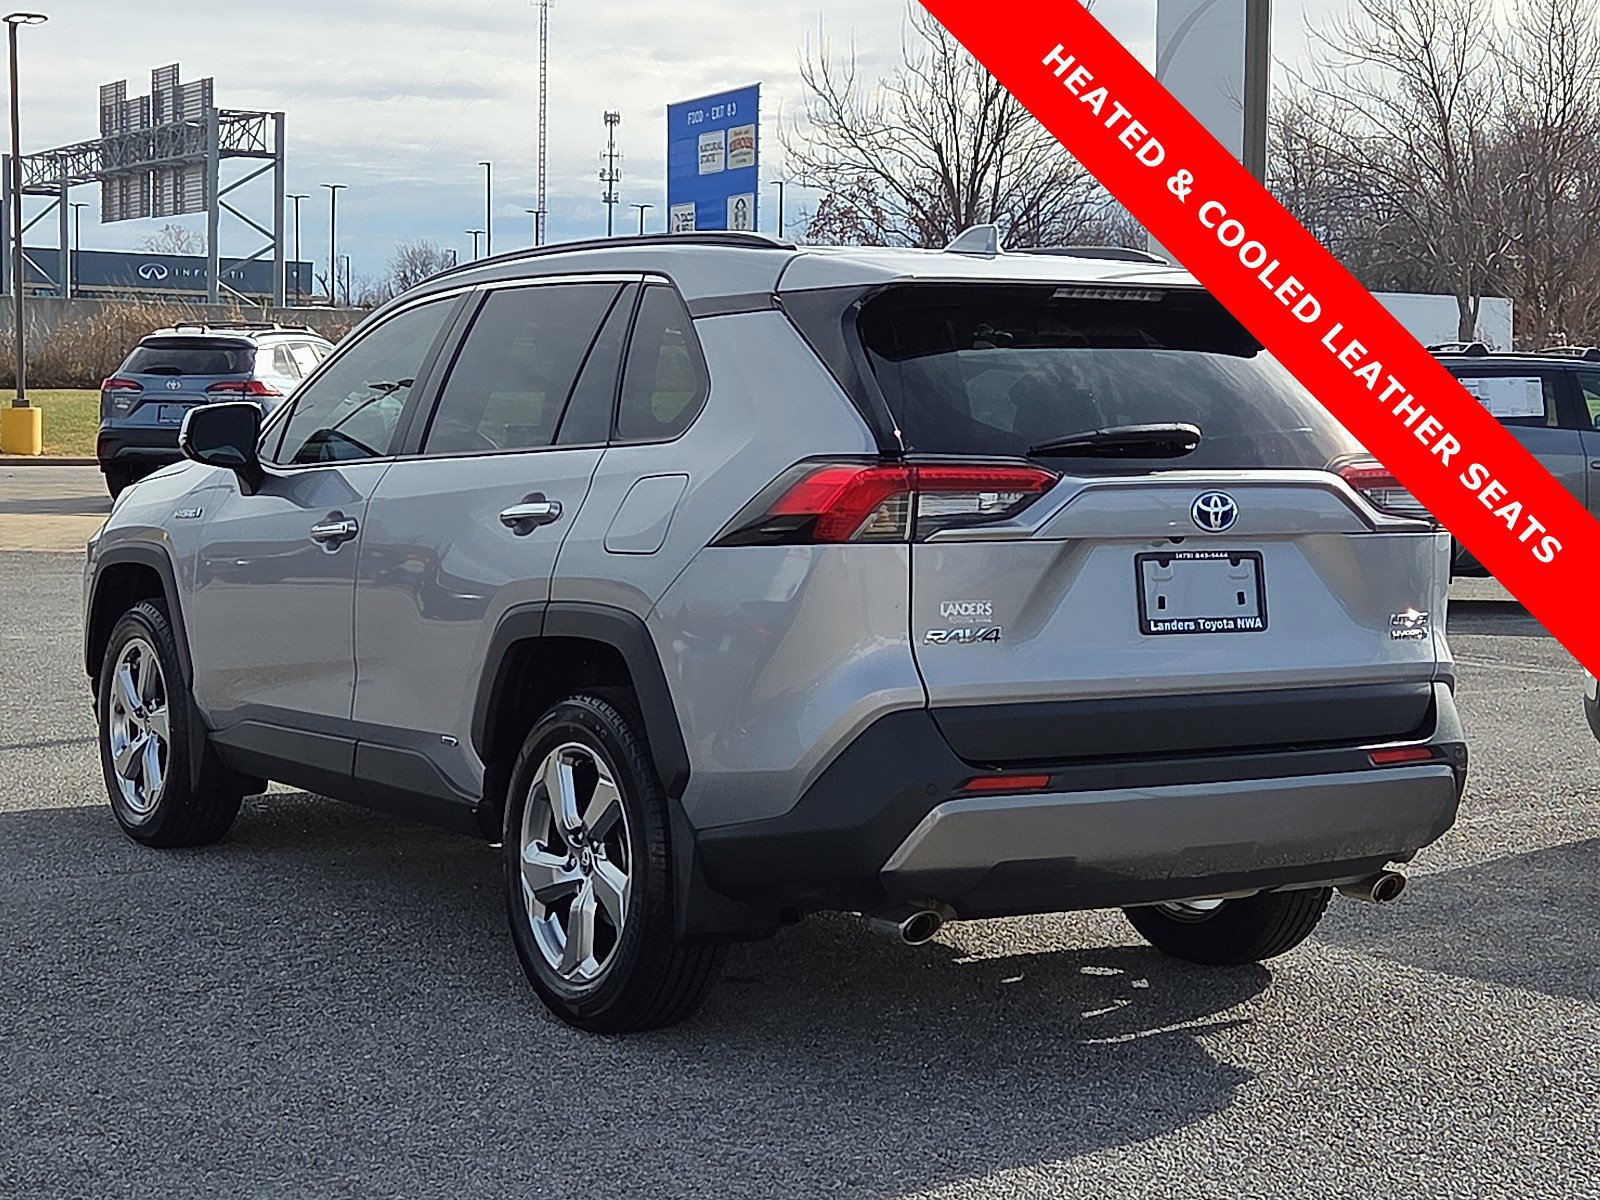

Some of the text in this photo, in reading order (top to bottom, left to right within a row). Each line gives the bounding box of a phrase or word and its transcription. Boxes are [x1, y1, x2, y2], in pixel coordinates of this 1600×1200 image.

[687, 109, 703, 125] FOOD
[711, 104, 725, 120] EXIT
[173, 268, 245, 280] INFITI
[940, 602, 992, 617] LANDERS
[1151, 617, 1263, 631] Landers Toyota NWA
[923, 626, 1002, 645] RAV4
